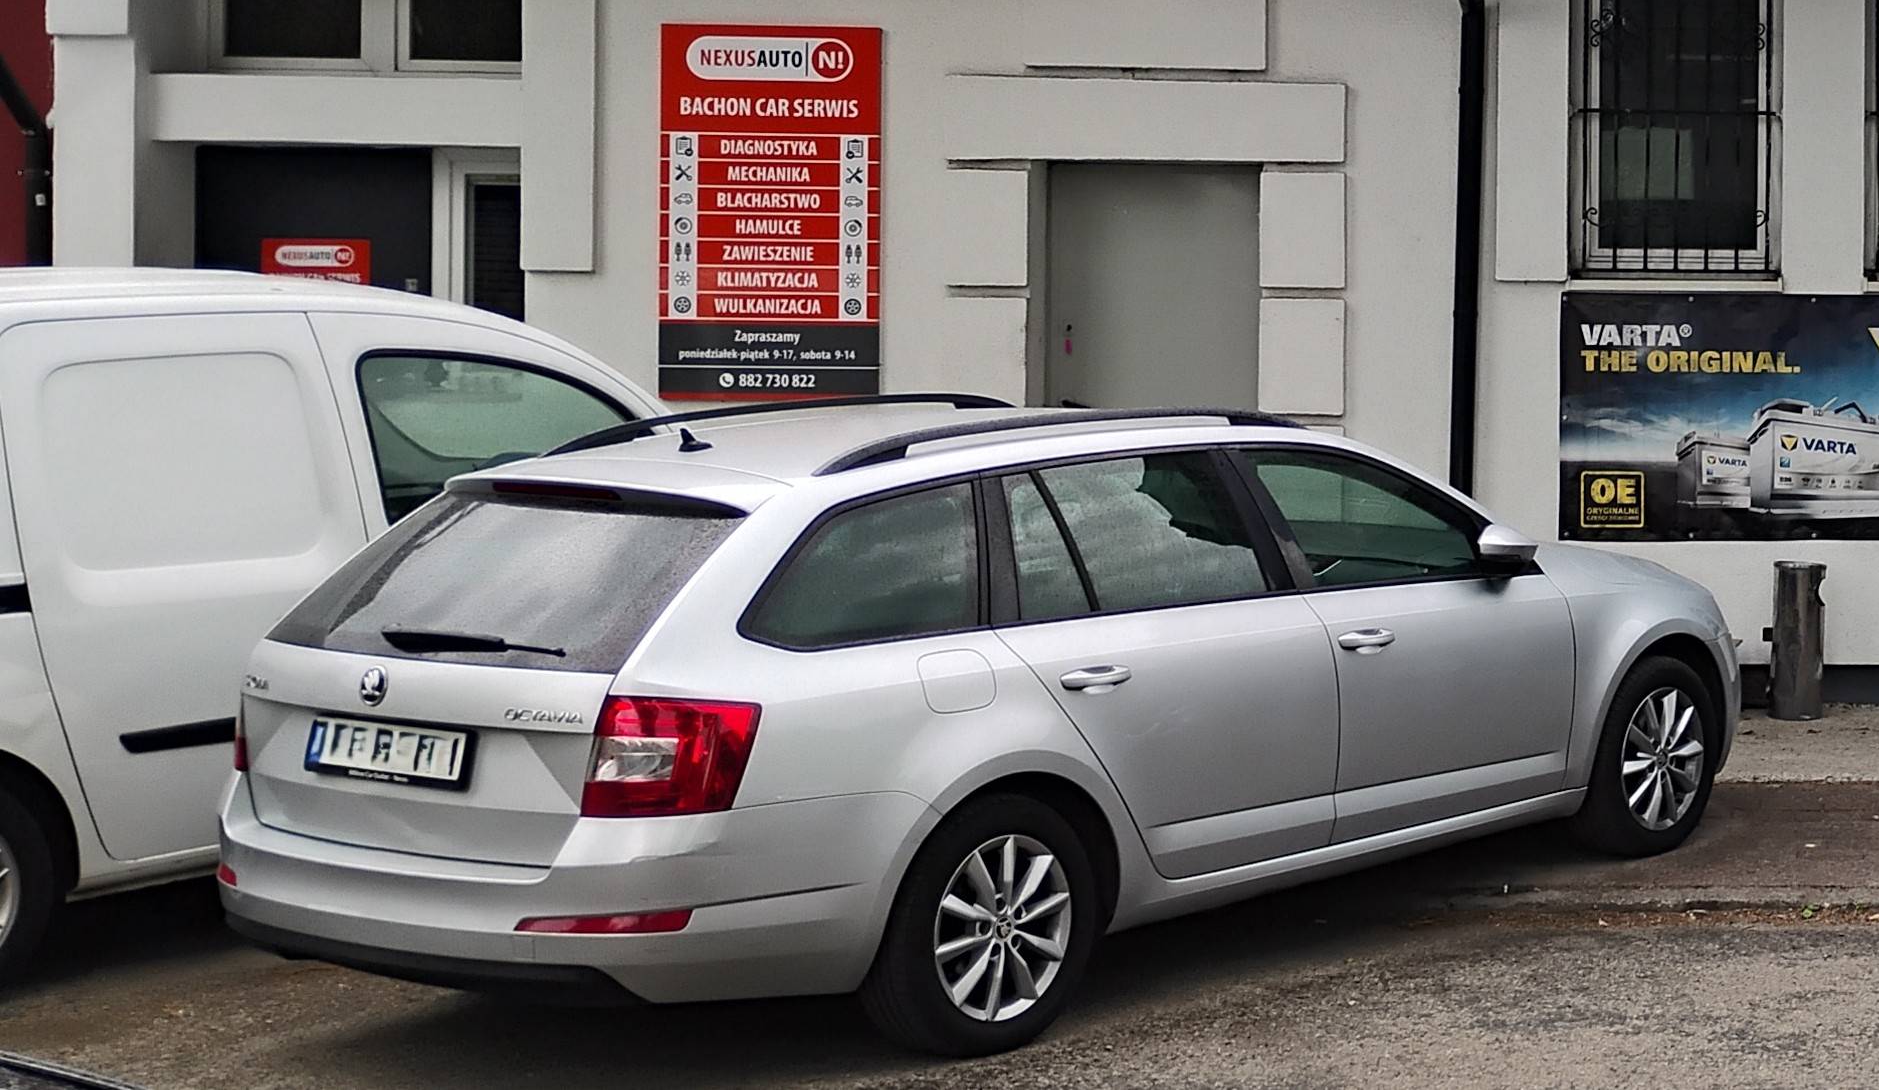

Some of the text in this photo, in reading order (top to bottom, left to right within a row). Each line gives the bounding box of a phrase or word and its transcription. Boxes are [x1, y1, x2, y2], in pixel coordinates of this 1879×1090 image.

[700, 49, 844, 69] NEXUSAUTO N!
[680, 97, 858, 118] BACHON CAR SERWIS
[720, 140, 818, 156] DIAGNOSTYKA
[727, 166, 810, 183] MECHANIKA
[716, 192, 820, 209] BLACHARSTWO
[735, 218, 801, 235] HAMULCE
[722, 245, 814, 261] ZAWIESZENIE
[717, 271, 818, 288] KLIMATYZACJA
[714, 297, 822, 315] WULKANIZACJA
[734, 330, 800, 345] Zapraszamy
[800, 349, 831, 360] sobota
[835, 350, 856, 360] 9-14
[1581, 350, 1801, 373] THE ORIGINAL.
[738, 374, 816, 388] 882 730 822
[1802, 437, 1857, 455] VARTA
[1718, 457, 1747, 467] VARTA
[1590, 478, 1636, 504] OE
[504, 708, 583, 724] OCTAVIA
